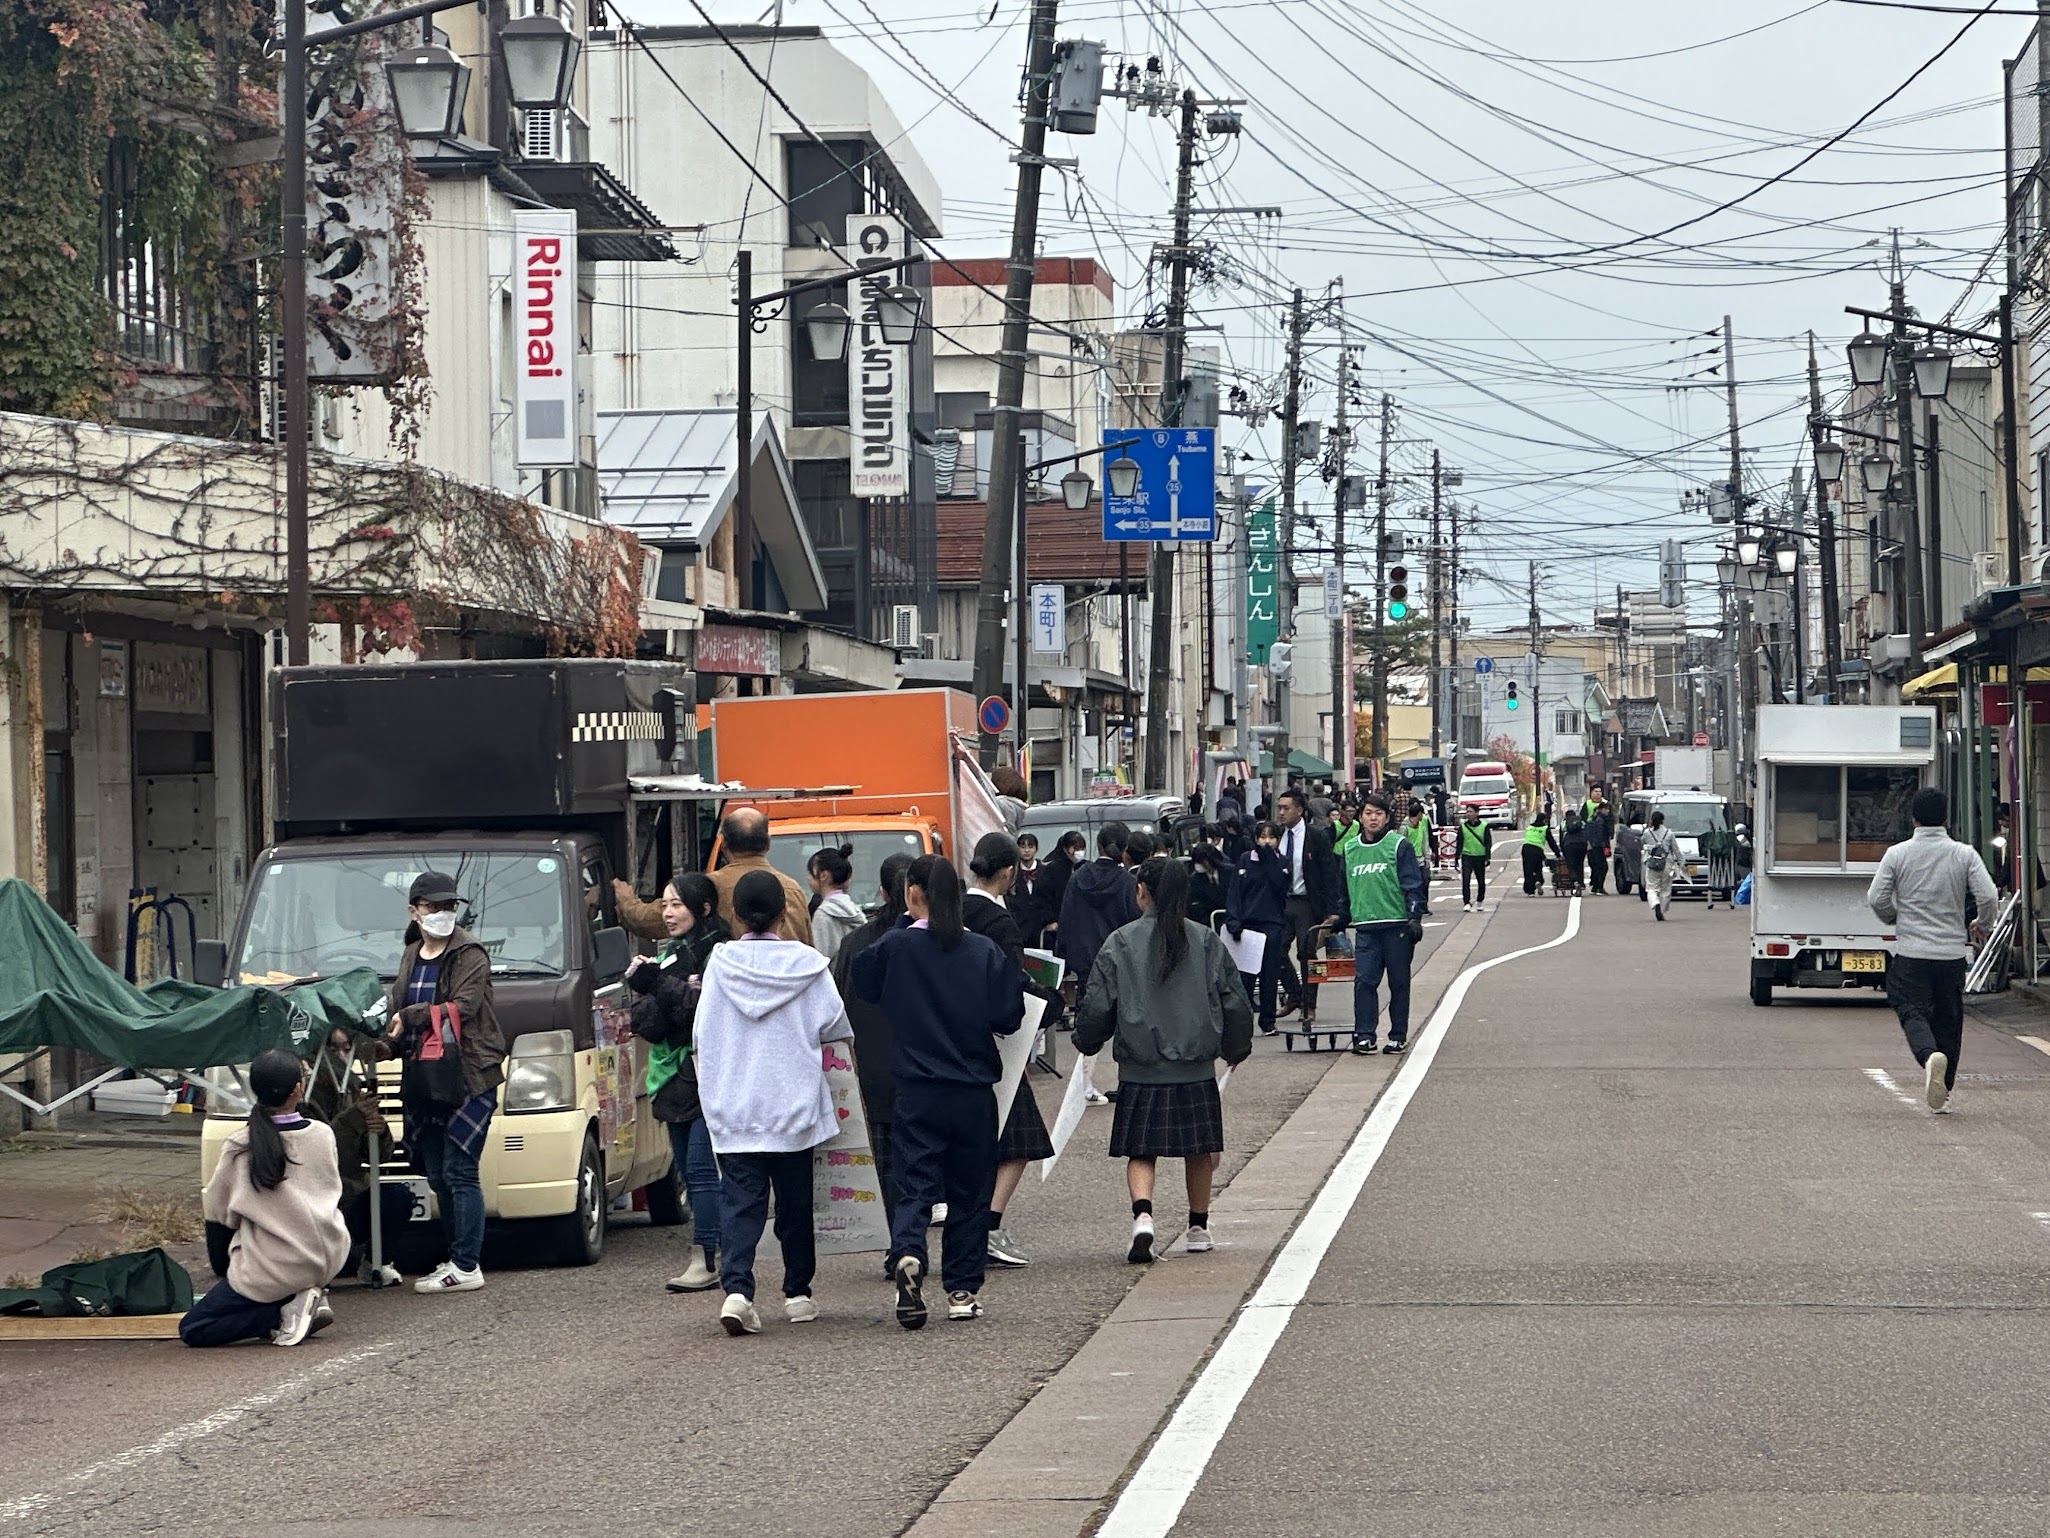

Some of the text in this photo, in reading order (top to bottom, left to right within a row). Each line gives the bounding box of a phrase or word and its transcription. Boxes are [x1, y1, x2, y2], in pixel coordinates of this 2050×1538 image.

[527, 238, 562, 377] Rinnai
[1351, 862, 1388, 877] STAFF
[1852, 959, 1882, 970] 35-83
